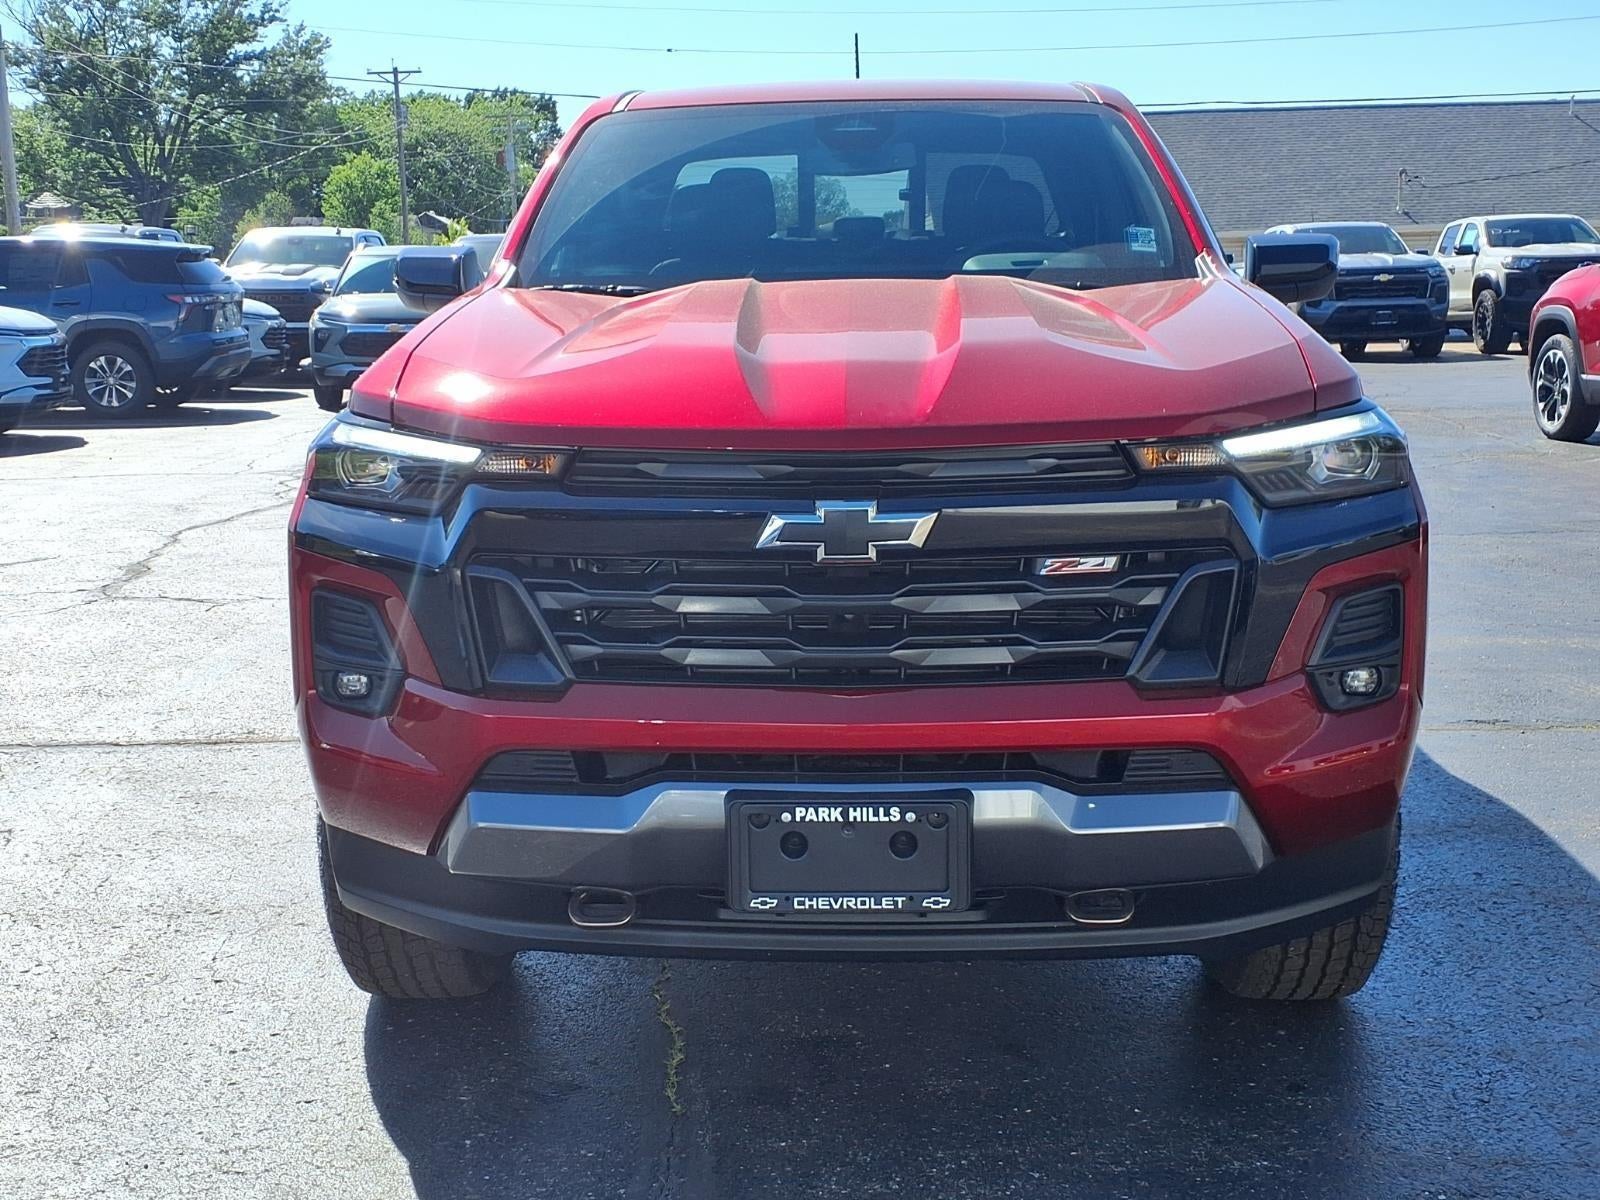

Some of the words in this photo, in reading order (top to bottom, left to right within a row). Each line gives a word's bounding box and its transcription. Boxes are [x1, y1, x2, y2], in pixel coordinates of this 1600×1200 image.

[1040, 556, 1117, 575] Z71
[795, 807, 843, 821] PARK
[849, 807, 901, 821] HILLS
[793, 897, 906, 909] CHEVROLET
